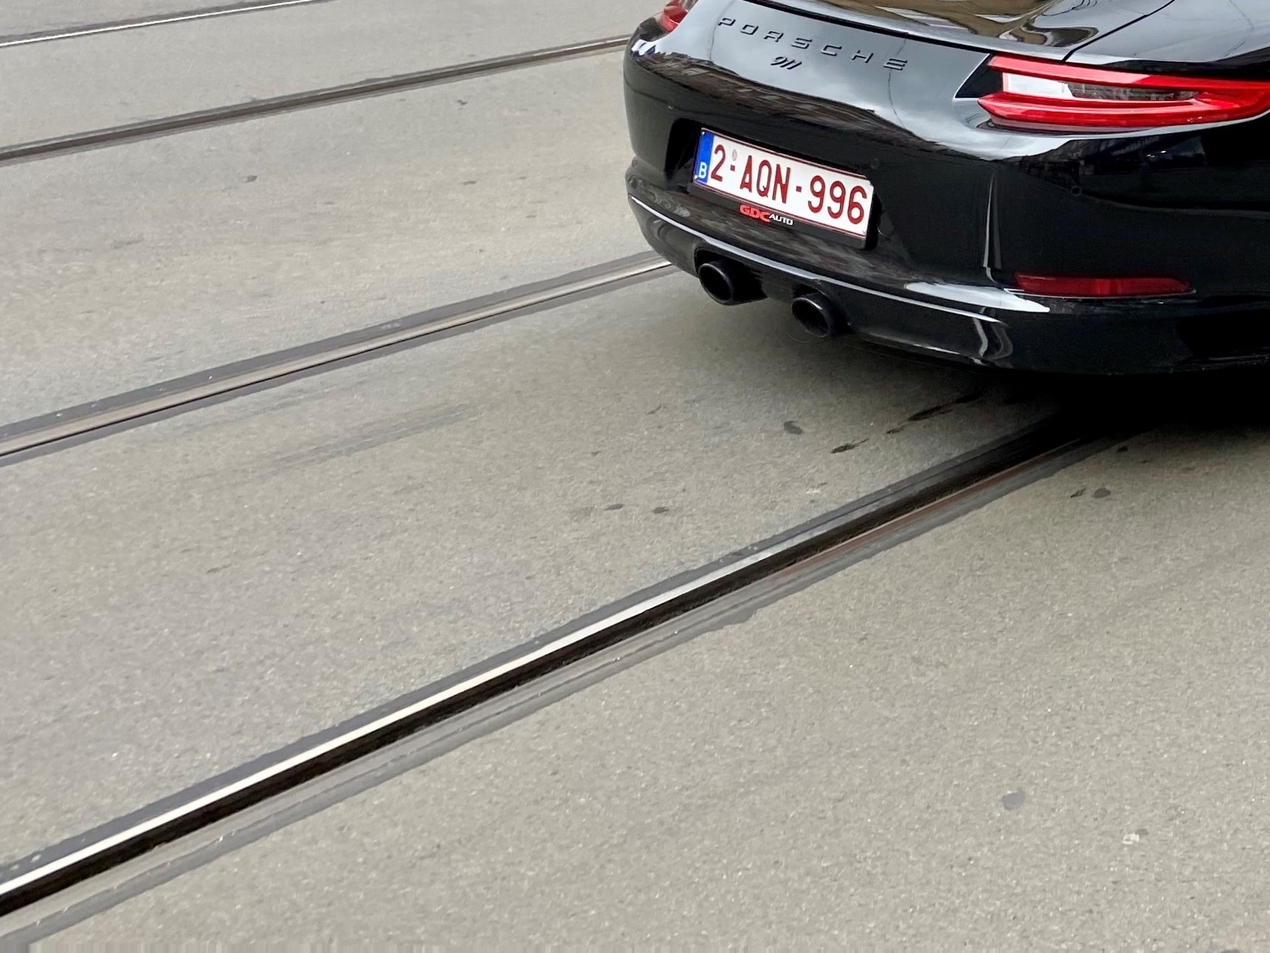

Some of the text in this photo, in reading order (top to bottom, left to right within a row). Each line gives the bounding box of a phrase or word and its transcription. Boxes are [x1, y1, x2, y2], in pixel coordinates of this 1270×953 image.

[718, 17, 908, 71] PORSCHE
[771, 56, 802, 70] 911
[711, 144, 867, 225] 2-AQN-996
